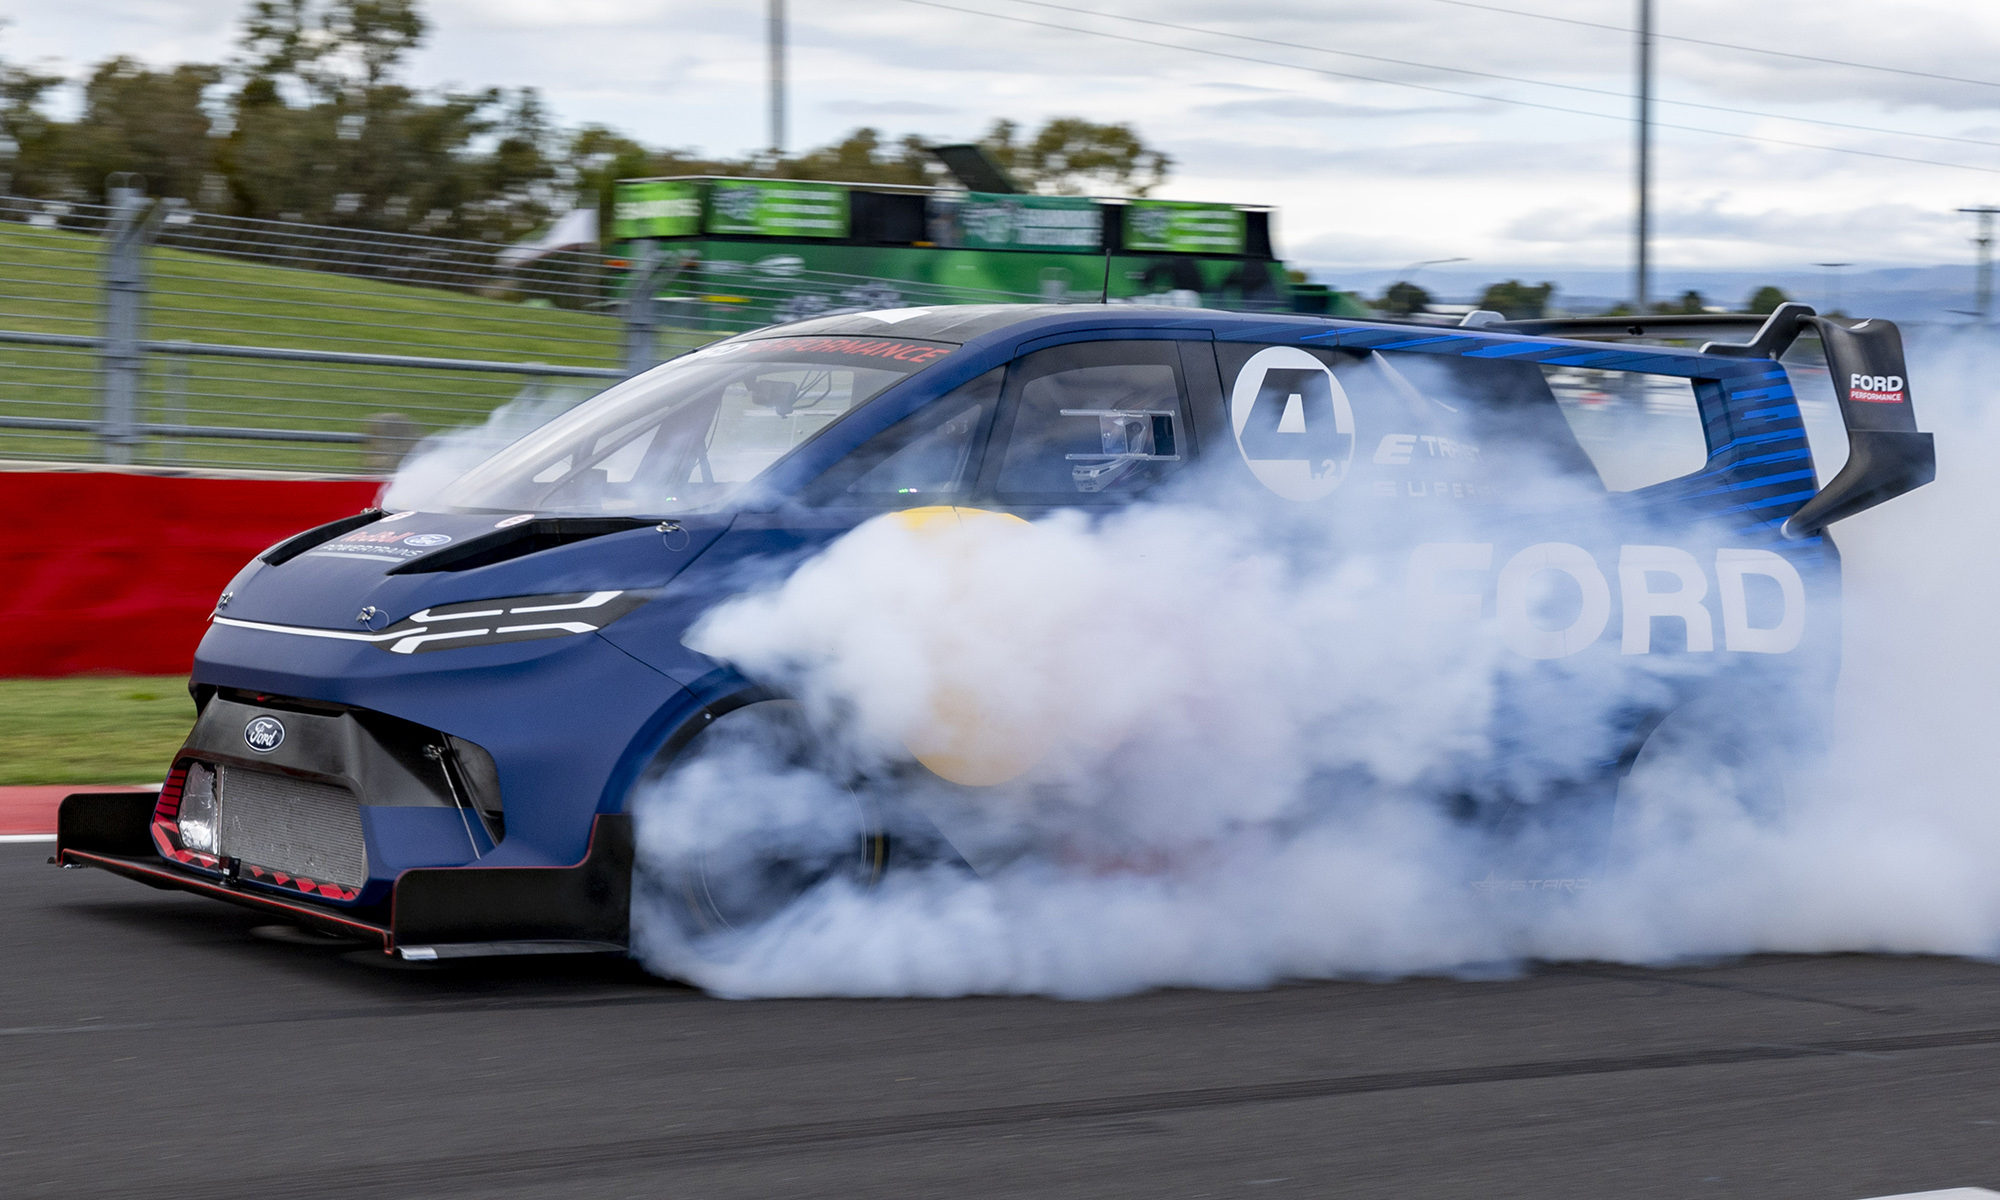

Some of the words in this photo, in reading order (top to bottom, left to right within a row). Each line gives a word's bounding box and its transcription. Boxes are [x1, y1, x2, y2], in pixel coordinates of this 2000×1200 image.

[1850, 373, 1904, 392] FORD
[1850, 391, 1902, 401] PERFORMANCE
[1371, 480, 1499, 498] SUPER
[1405, 541, 1806, 660] FORD
[249, 720, 278, 747] Ford
